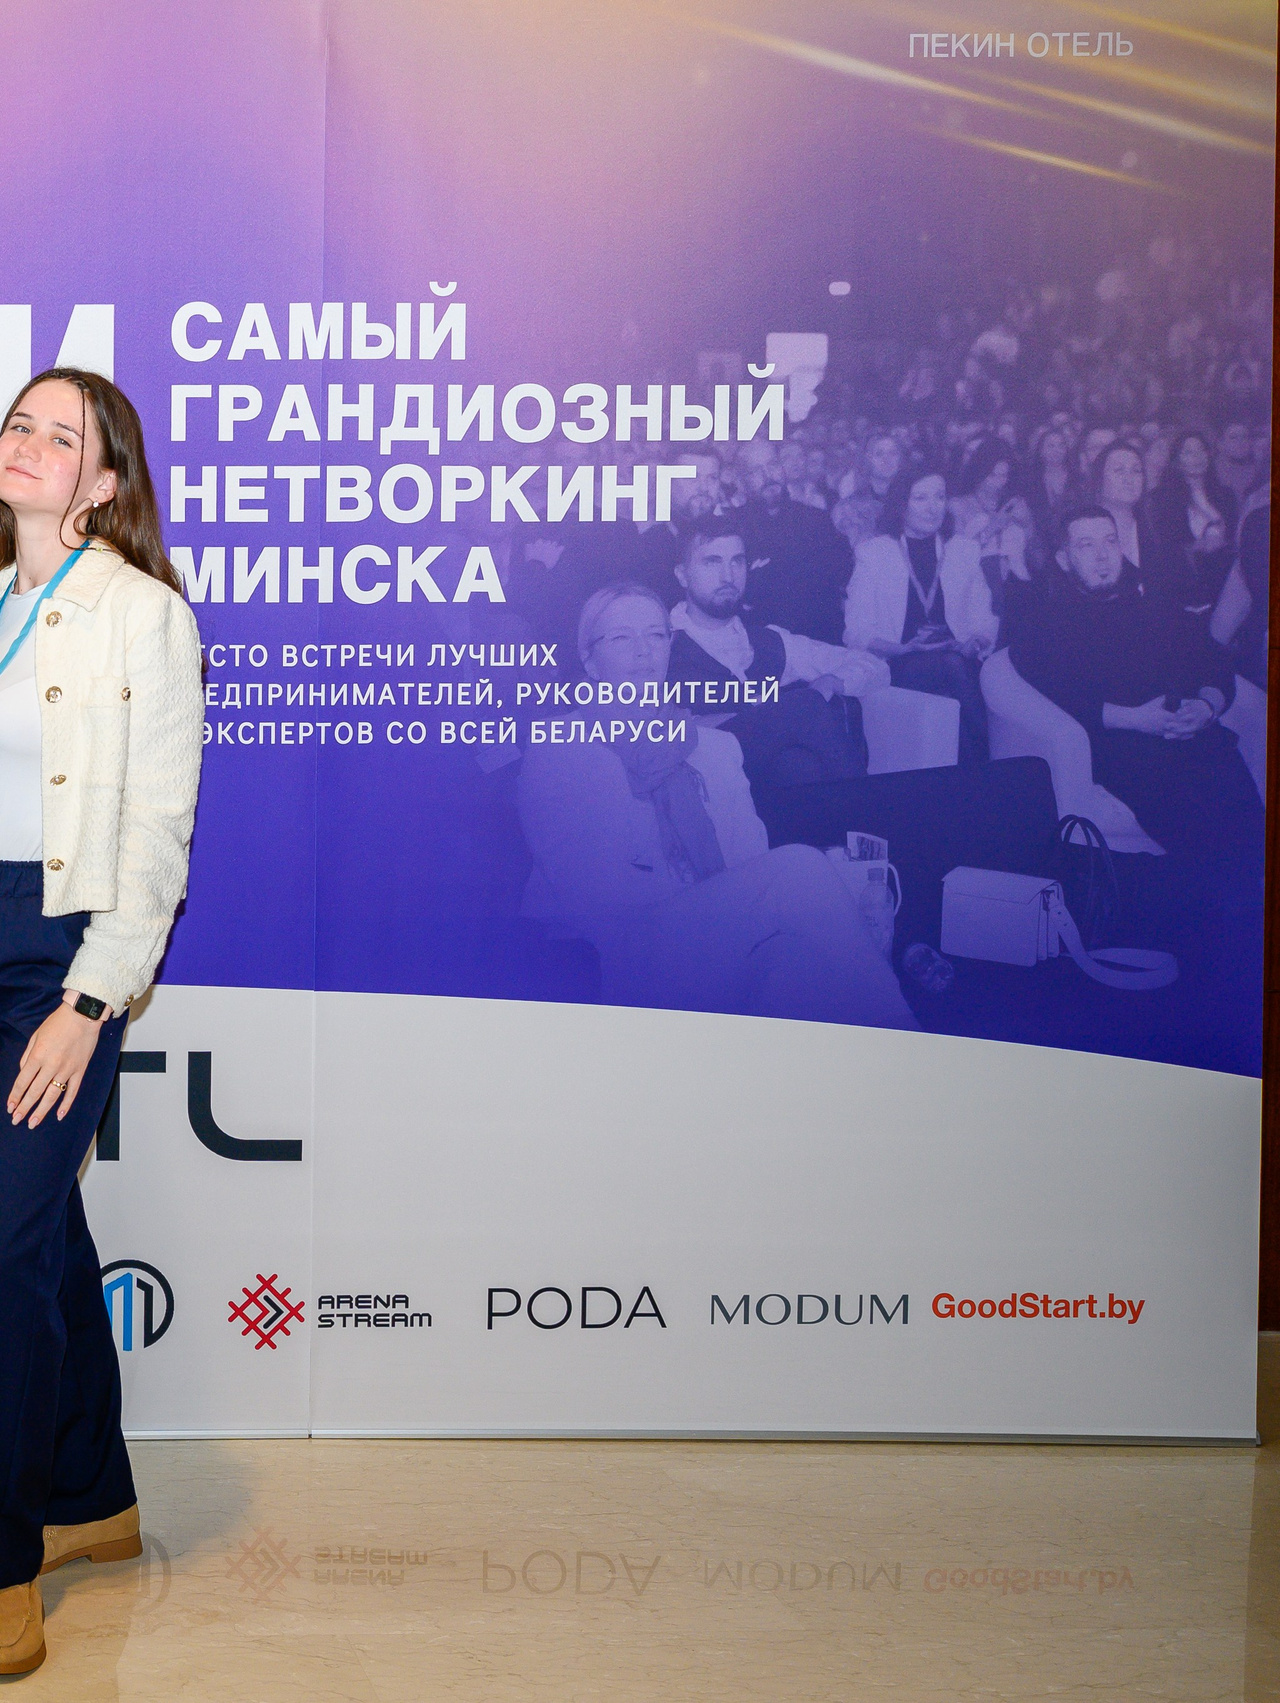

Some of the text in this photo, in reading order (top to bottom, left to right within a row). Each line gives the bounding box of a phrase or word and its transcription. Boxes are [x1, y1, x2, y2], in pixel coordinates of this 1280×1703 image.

[909, 32, 1134, 58] ПЕКИН ОТЕЛЬ
[171, 281, 466, 362] САМЫЙ
[170, 363, 784, 455] ГРАНДИОЗНЫЙ
[170, 463, 697, 524] НЕТВОРКИНГ
[169, 544, 507, 605] МИНСКА
[201, 643, 558, 667] СТО ВСТРЕЧИ ЛУЧШИХ
[516, 676, 780, 708] РУКОВОДИТЕЛЕЙ
[203, 716, 687, 745] ЭКСПЕРТОВ СО ВСЕЙ БЕЛАРУСИ
[317, 1294, 410, 1310] ARENA
[486, 1286, 668, 1331] PODA
[709, 1293, 910, 1326] MODUM
[930, 1292, 1146, 1325] GoodStart.by
[317, 1312, 433, 1328] STREAM
